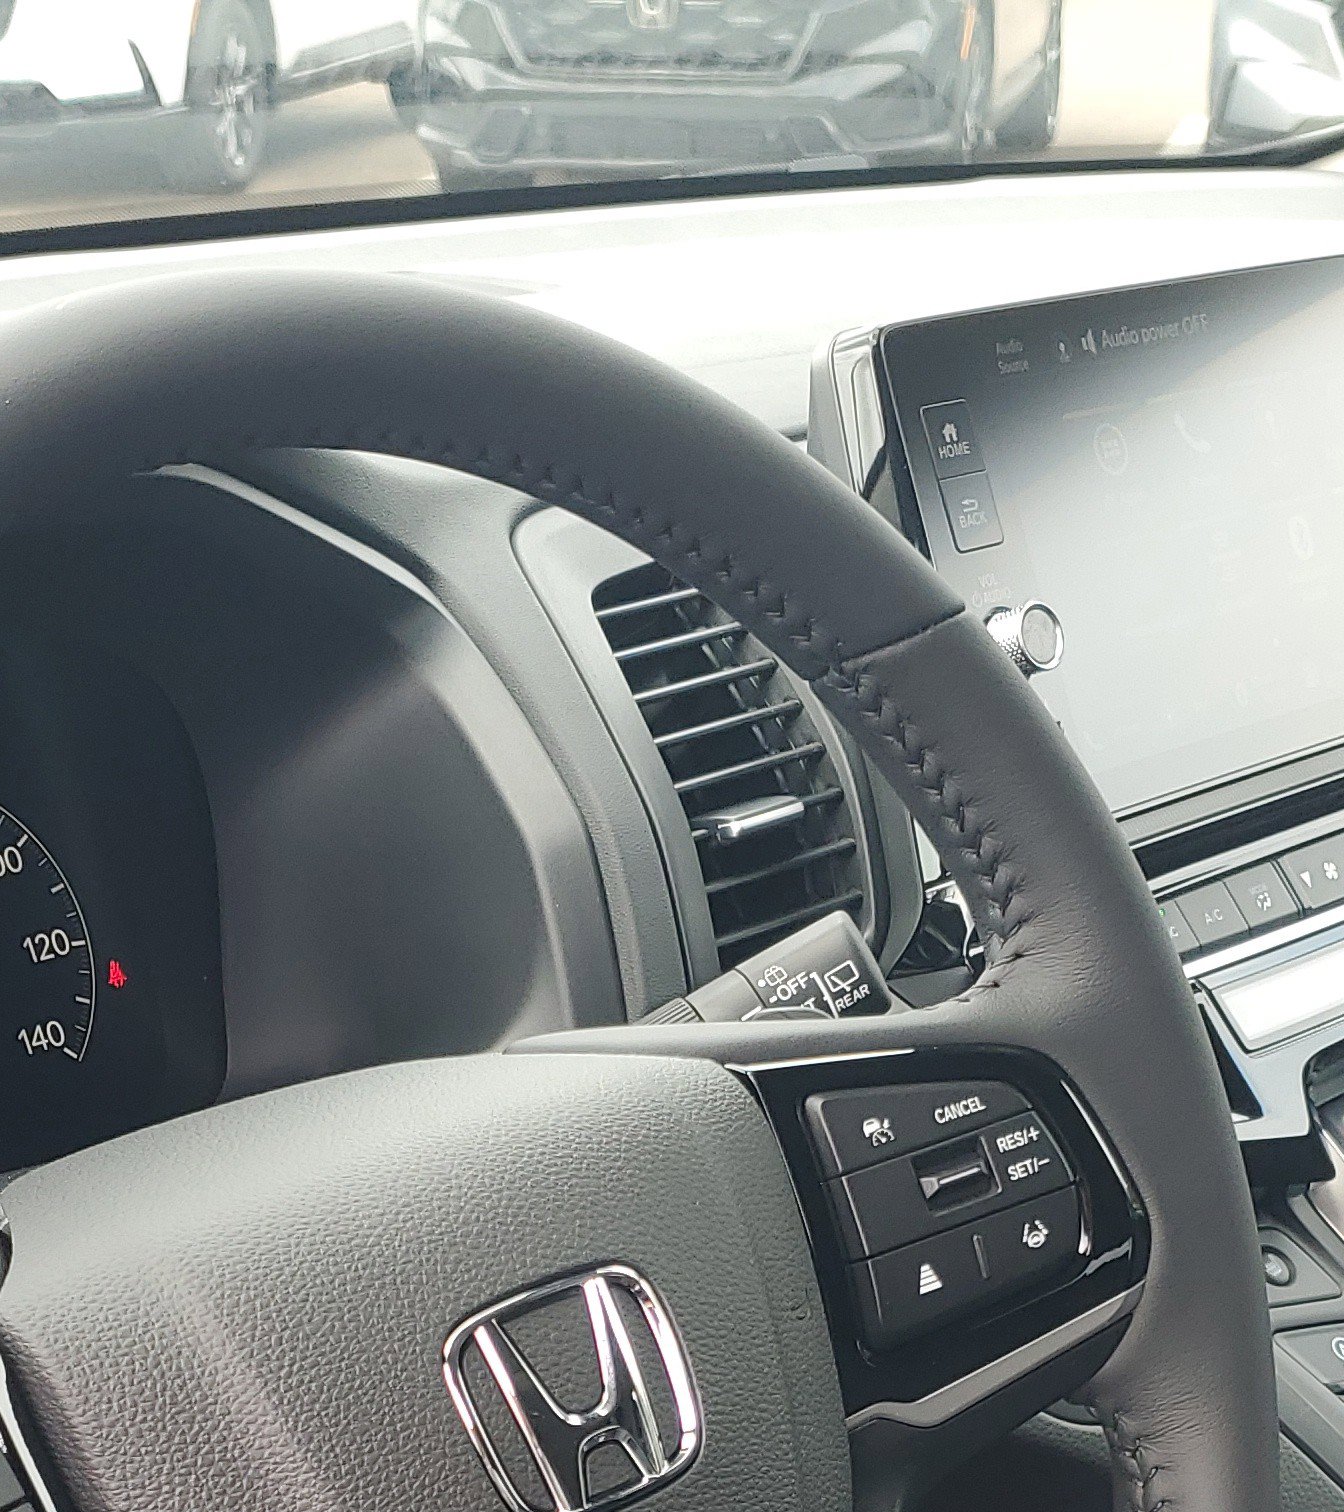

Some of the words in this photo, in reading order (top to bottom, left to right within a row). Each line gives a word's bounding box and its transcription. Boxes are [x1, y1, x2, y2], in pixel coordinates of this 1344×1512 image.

[1101, 326, 1139, 349] Audio
[1141, 322, 1179, 344] power
[938, 441, 971, 459] HOME
[958, 512, 987, 529] BACK
[22, 928, 72, 964] 120
[776, 971, 809, 1001] OFF
[835, 983, 871, 1012] REAR
[17, 1019, 66, 1056] 140
[934, 1096, 987, 1124] CANCEL
[996, 1126, 1040, 1153] RES/+
